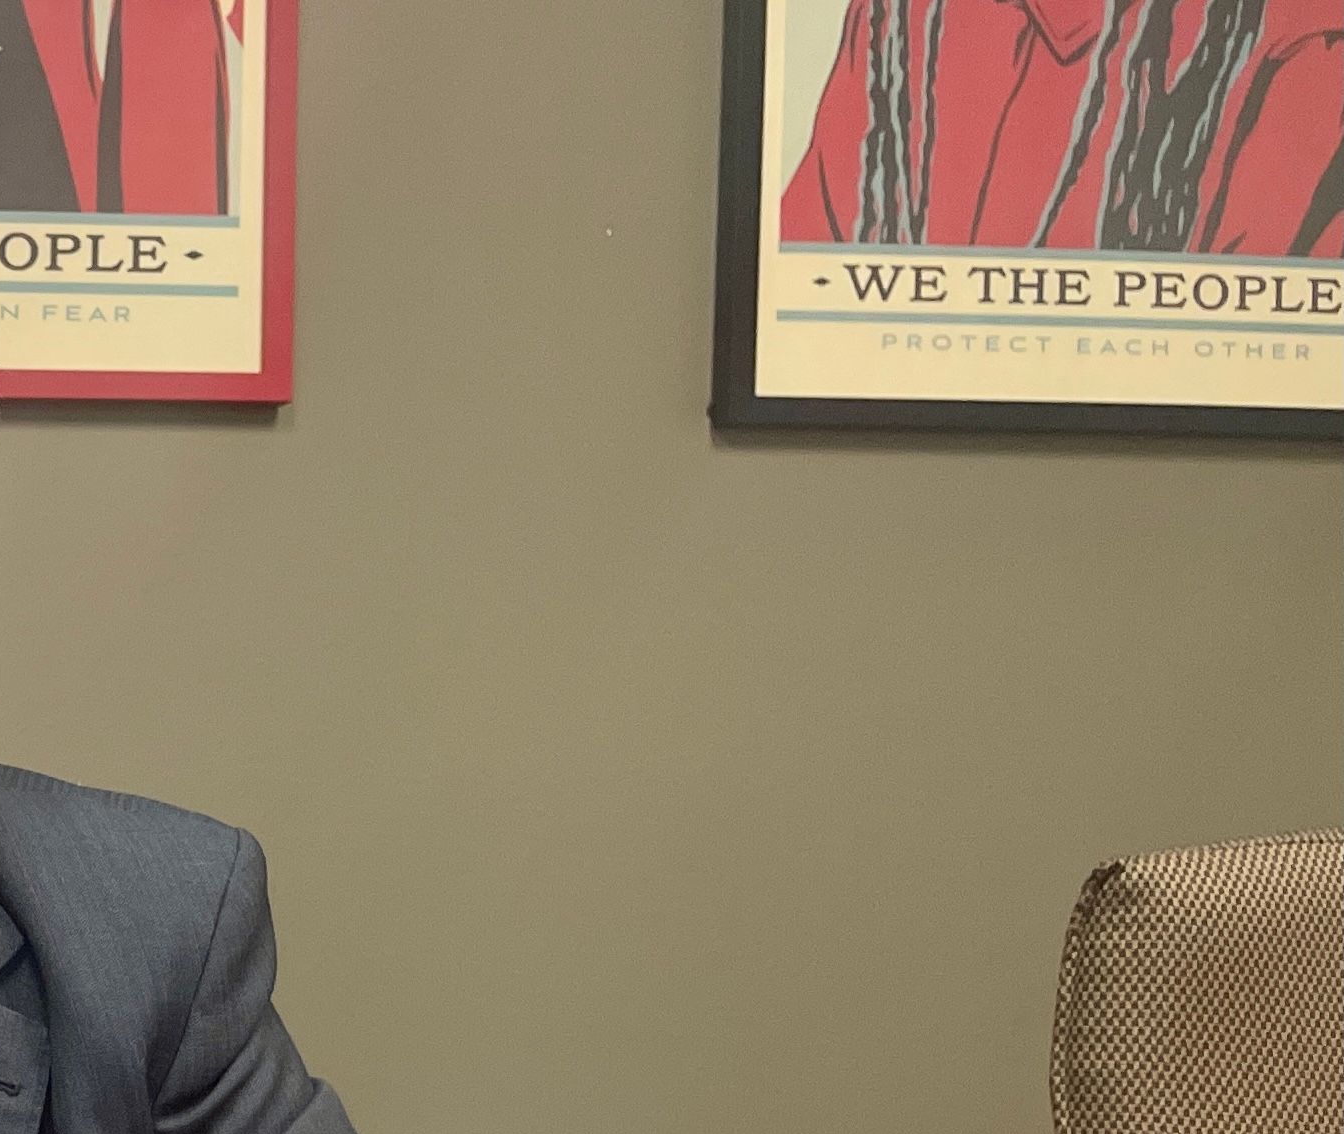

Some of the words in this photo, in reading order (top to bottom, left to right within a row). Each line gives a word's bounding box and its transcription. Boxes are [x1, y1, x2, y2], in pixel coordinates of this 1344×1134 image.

[843, 264, 948, 302] WE
[968, 266, 1092, 306] THE
[1114, 270, 1343, 314] PEOPLE
[42, 304, 131, 322] FEAR
[881, 332, 1053, 353] PROTECT
[1077, 337, 1170, 356] EACH
[1194, 340, 1310, 360] OTHER
